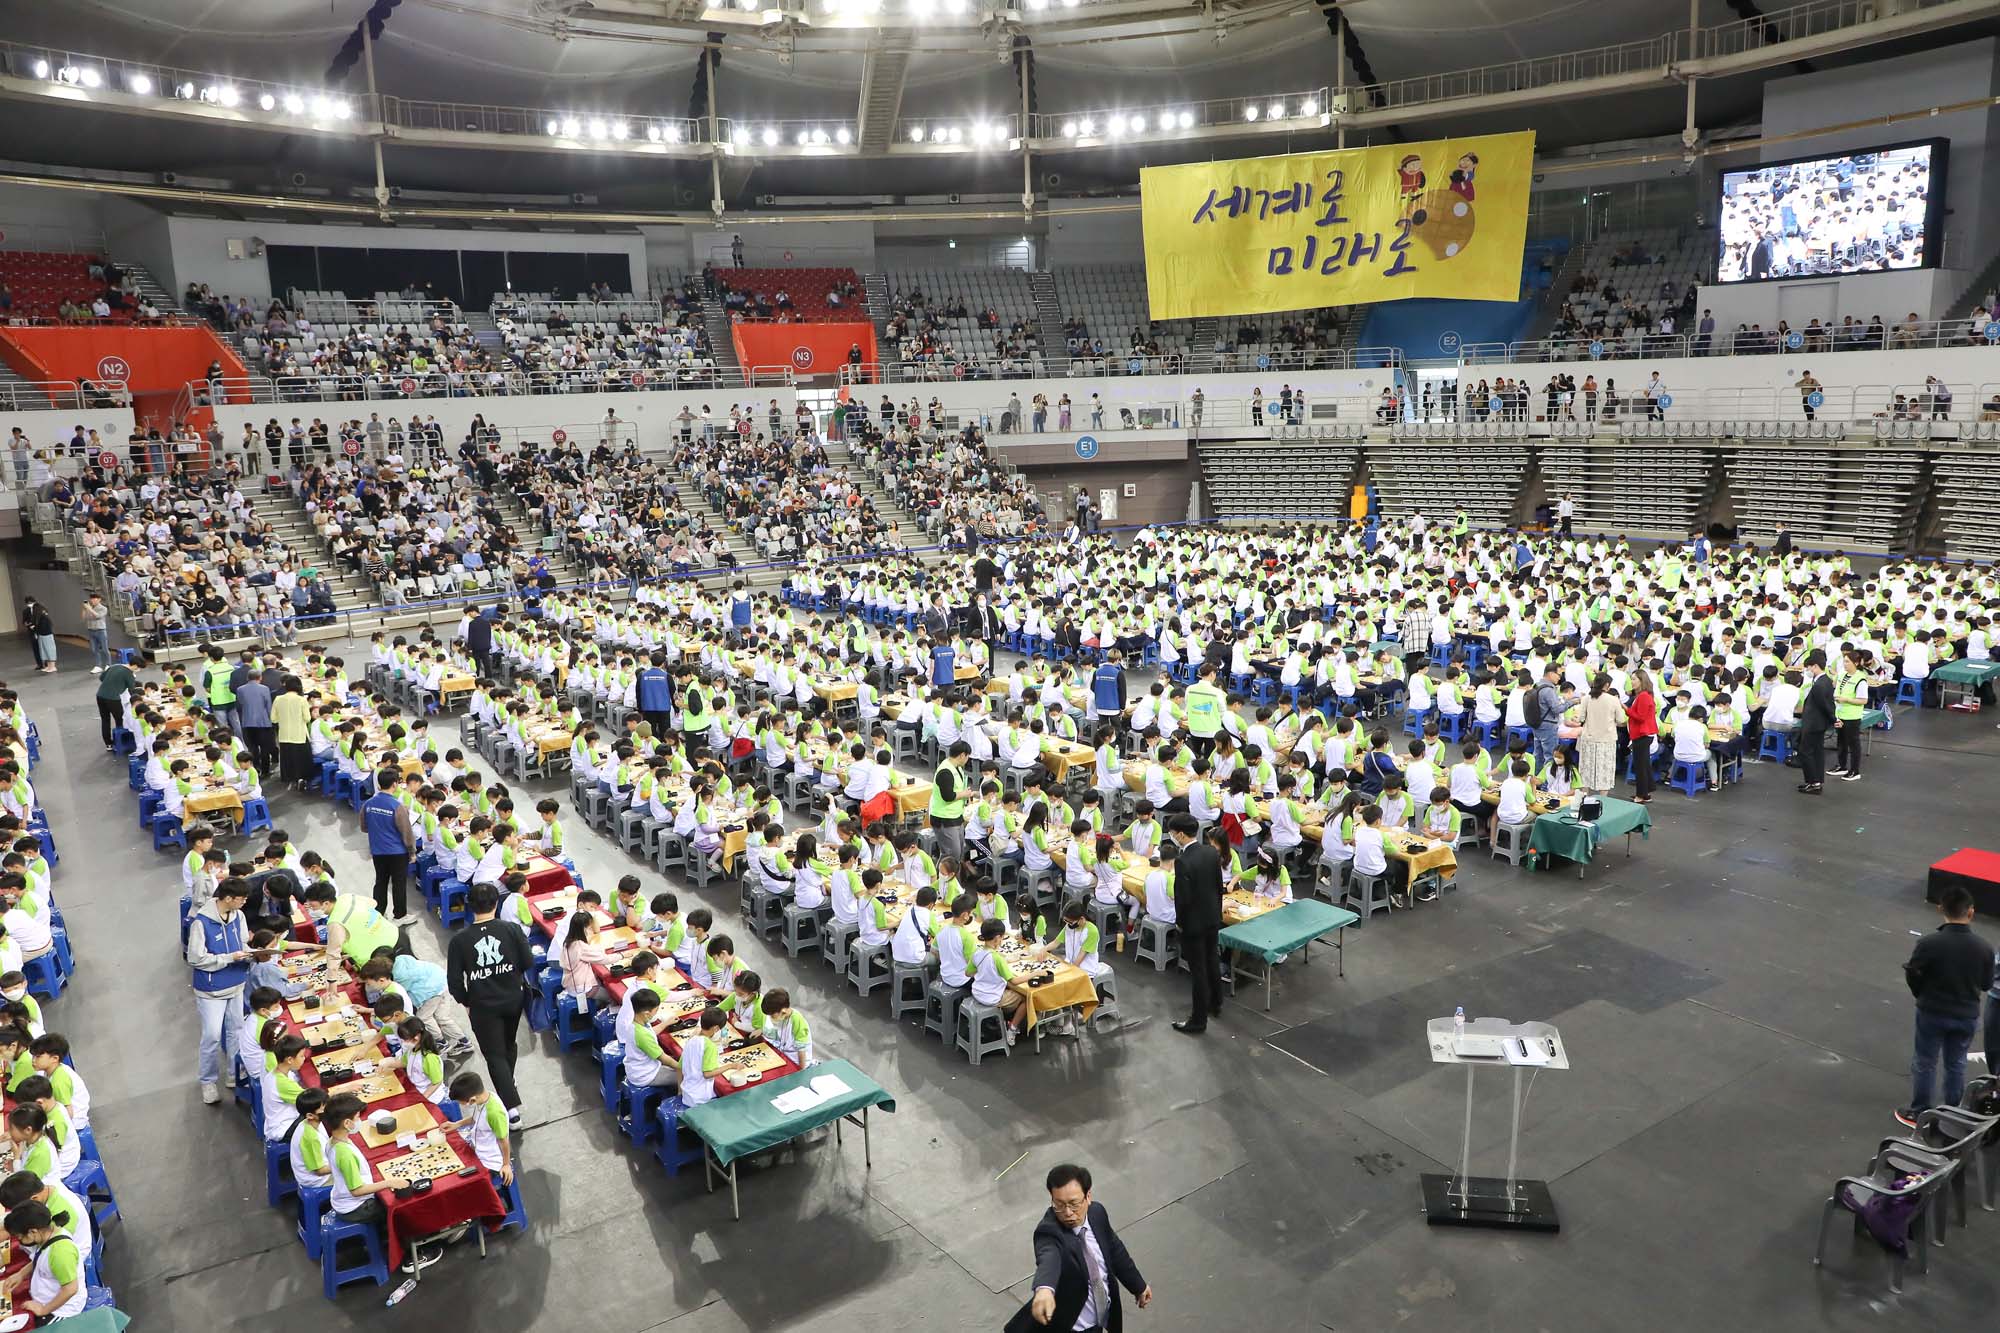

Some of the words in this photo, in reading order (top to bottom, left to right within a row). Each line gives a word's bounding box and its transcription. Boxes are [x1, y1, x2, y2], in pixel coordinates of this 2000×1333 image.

[1193, 170, 1348, 227] 세계로
[1268, 219, 1417, 277] 미래로
[1443, 336, 1457, 346] E2
[796, 351, 810, 361] N3
[104, 363, 124, 375] N2
[1080, 441, 1092, 451] E1
[103, 456, 113, 464] 07
[470, 967, 492, 981] MLB
